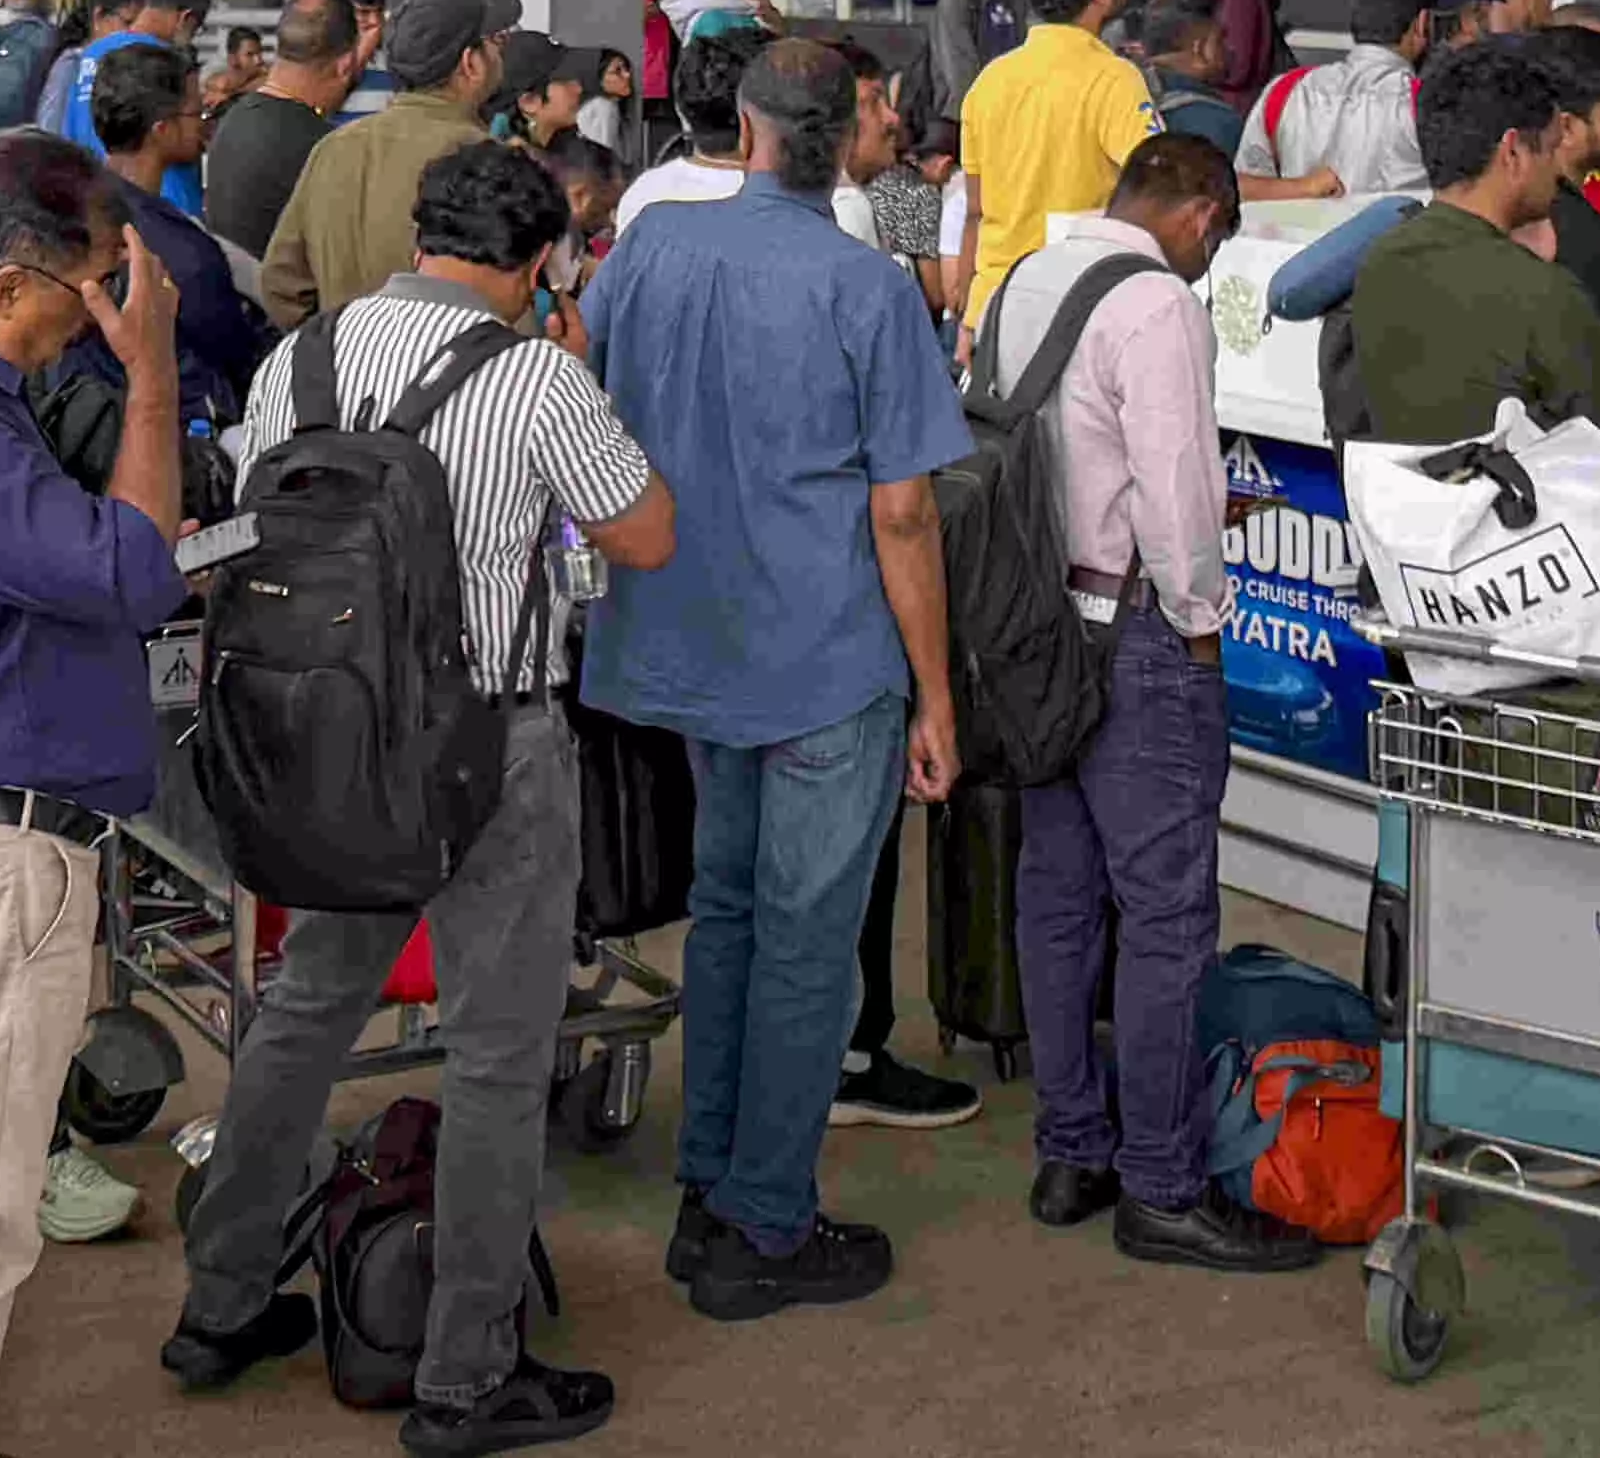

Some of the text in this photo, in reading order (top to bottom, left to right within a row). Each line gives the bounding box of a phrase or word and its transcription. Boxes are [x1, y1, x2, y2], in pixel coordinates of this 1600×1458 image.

[1245, 578, 1310, 612] CRUISE
[1312, 594, 1364, 622] THRO
[1417, 553, 1571, 625] HANZO
